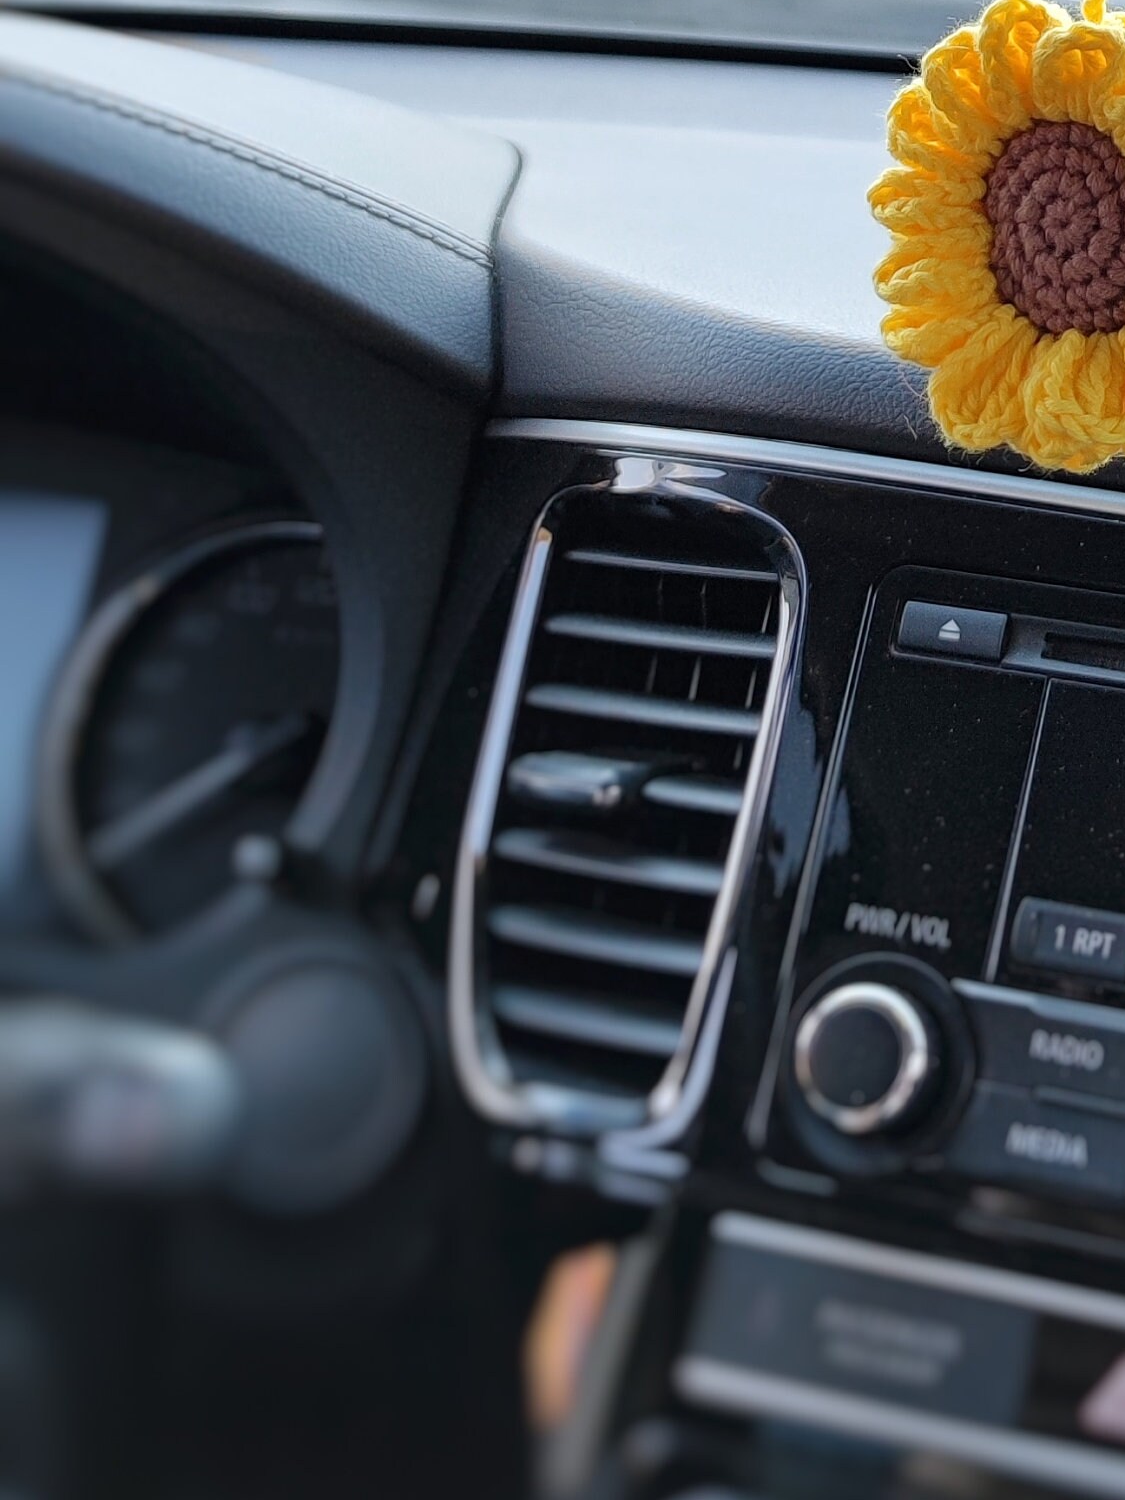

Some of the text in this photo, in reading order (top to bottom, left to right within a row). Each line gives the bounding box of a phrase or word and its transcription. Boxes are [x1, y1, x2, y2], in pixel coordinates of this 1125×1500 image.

[844, 902, 951, 950] PWR/VOL
[1054, 925, 1116, 959] 1 RPT
[1029, 1029, 1104, 1071] RADIO
[1006, 1121, 1089, 1168] MEDIA
